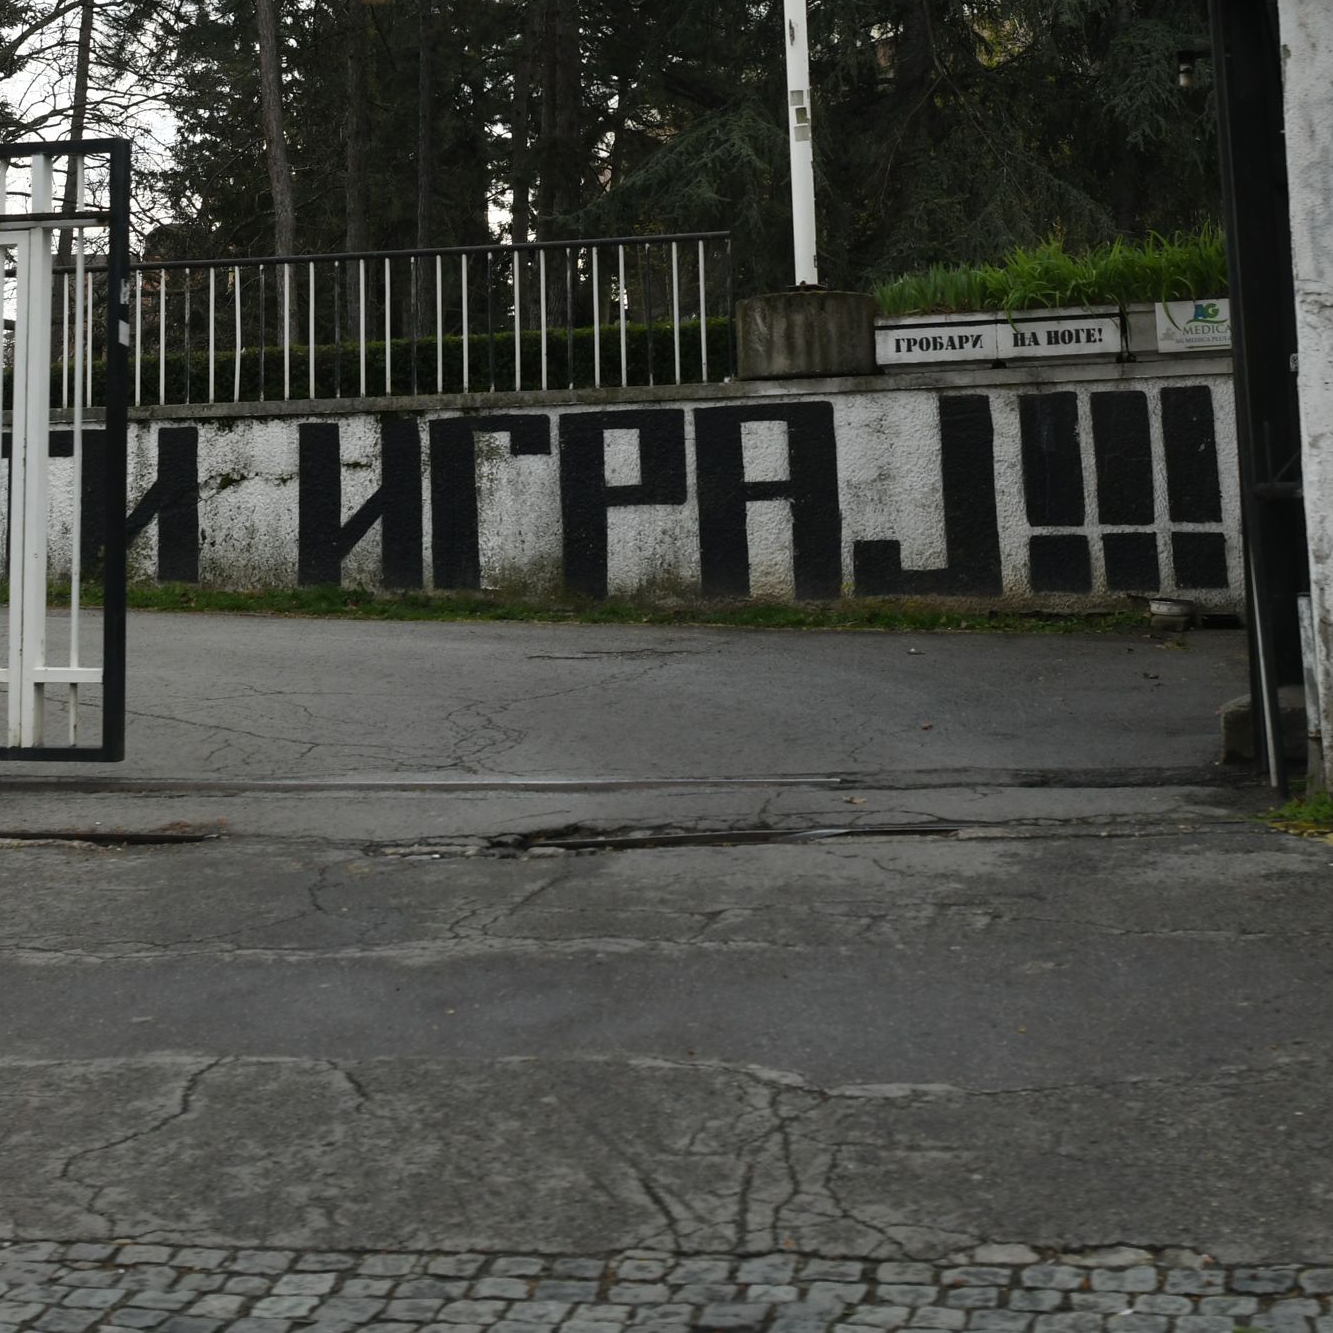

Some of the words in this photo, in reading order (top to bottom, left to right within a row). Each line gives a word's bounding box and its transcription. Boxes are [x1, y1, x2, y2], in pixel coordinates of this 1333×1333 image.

[895, 334, 983, 353] ГРОБАРИ
[1012, 332, 1040, 348] НА
[1046, 328, 1103, 346] НОГЕ!
